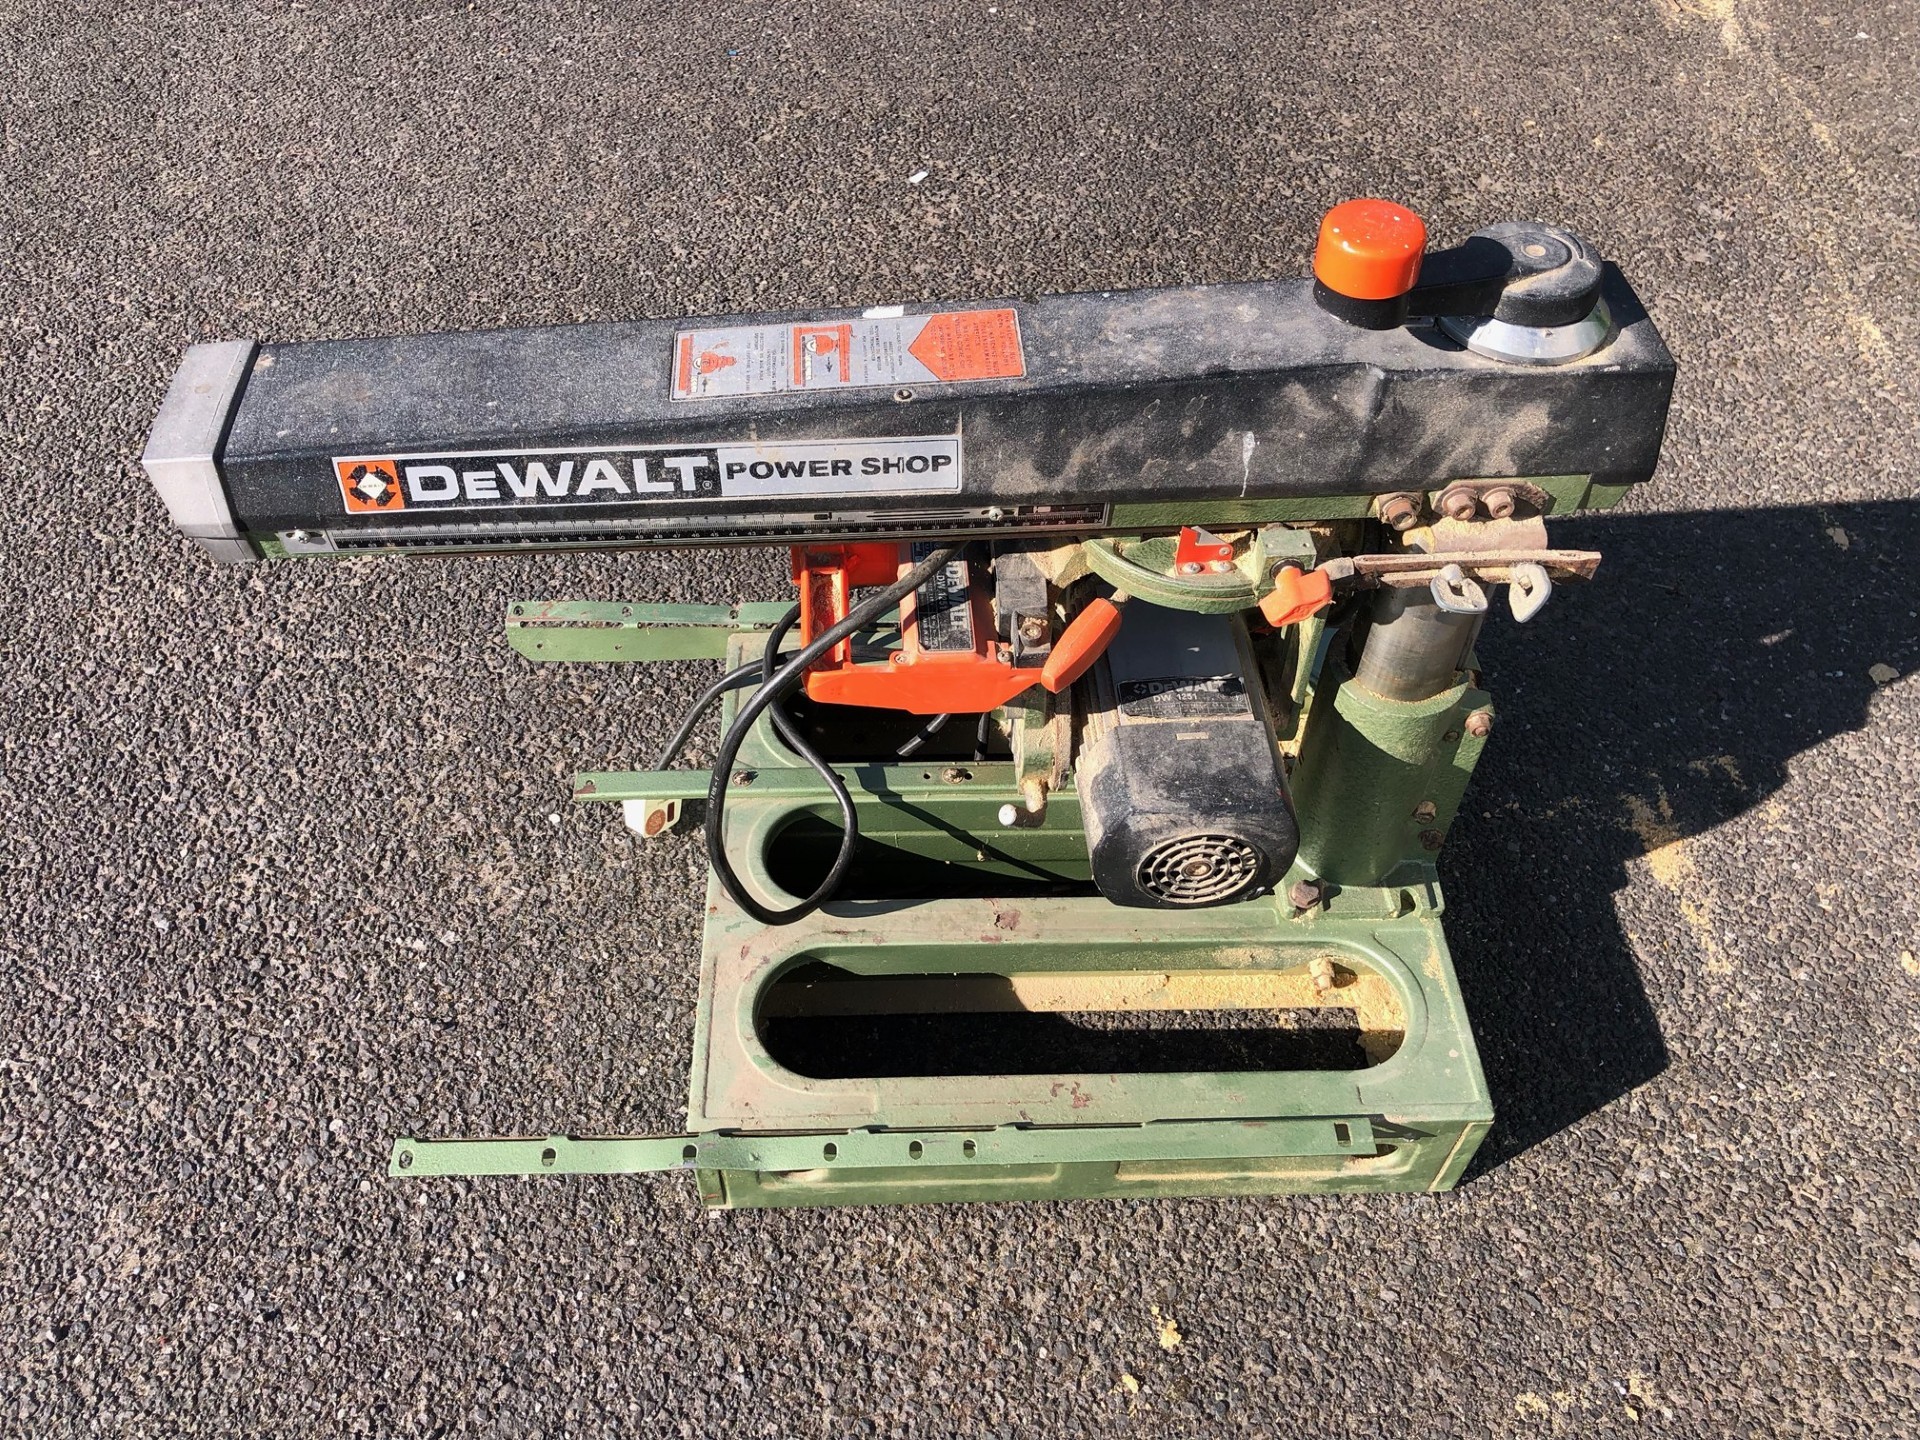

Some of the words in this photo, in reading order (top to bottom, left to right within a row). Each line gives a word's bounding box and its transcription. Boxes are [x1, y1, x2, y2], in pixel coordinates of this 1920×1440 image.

[405, 456, 708, 502] DEWALT
[726, 459, 853, 480] POWER
[861, 454, 952, 476] SHOP
[936, 575, 946, 590] DW
[946, 566, 968, 629] DEWALT
[1147, 680, 1227, 694] DEWALT
[1153, 694, 1172, 703] DW
[1177, 692, 1198, 701] 1251
